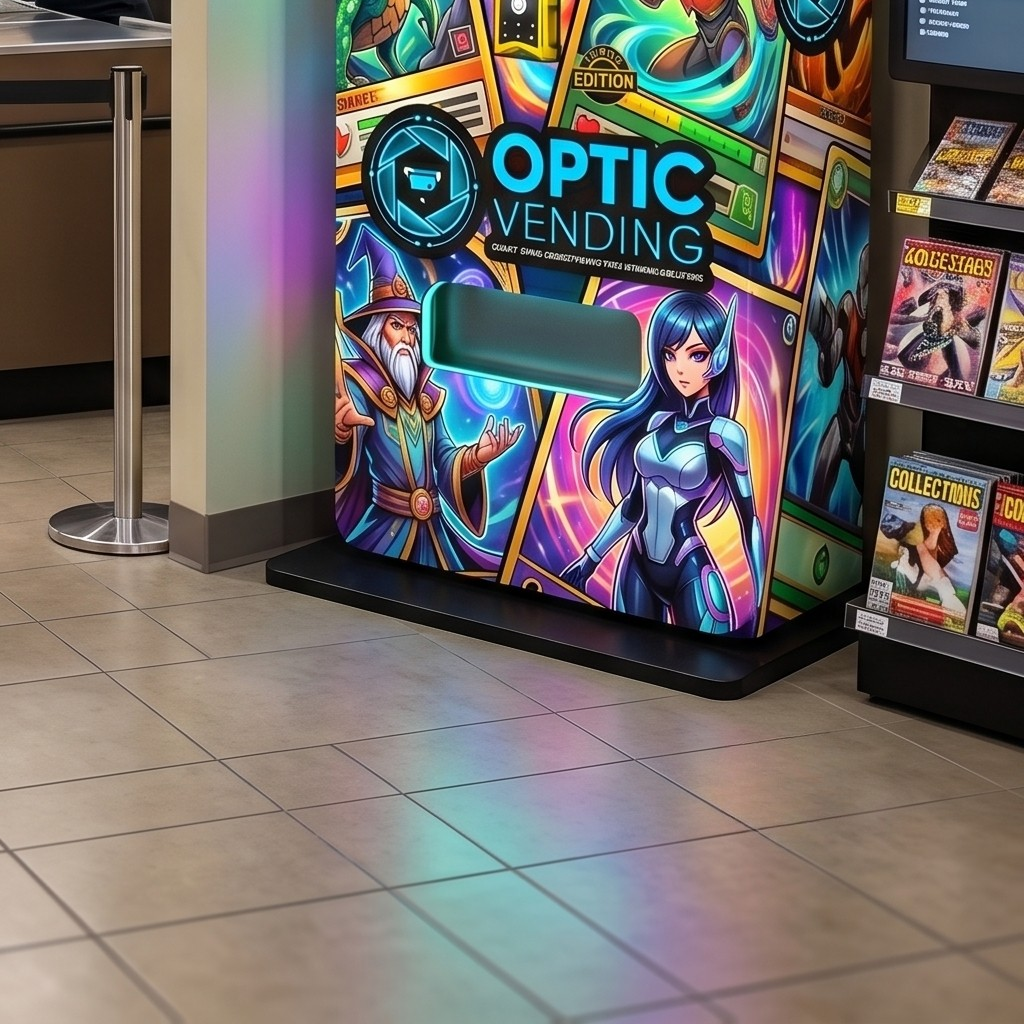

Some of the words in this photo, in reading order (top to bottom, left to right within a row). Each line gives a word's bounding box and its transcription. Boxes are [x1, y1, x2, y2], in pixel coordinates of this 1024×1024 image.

[574, 72, 634, 89] EDITION
[492, 132, 705, 217] OPTIC
[493, 198, 704, 266] VENDING
